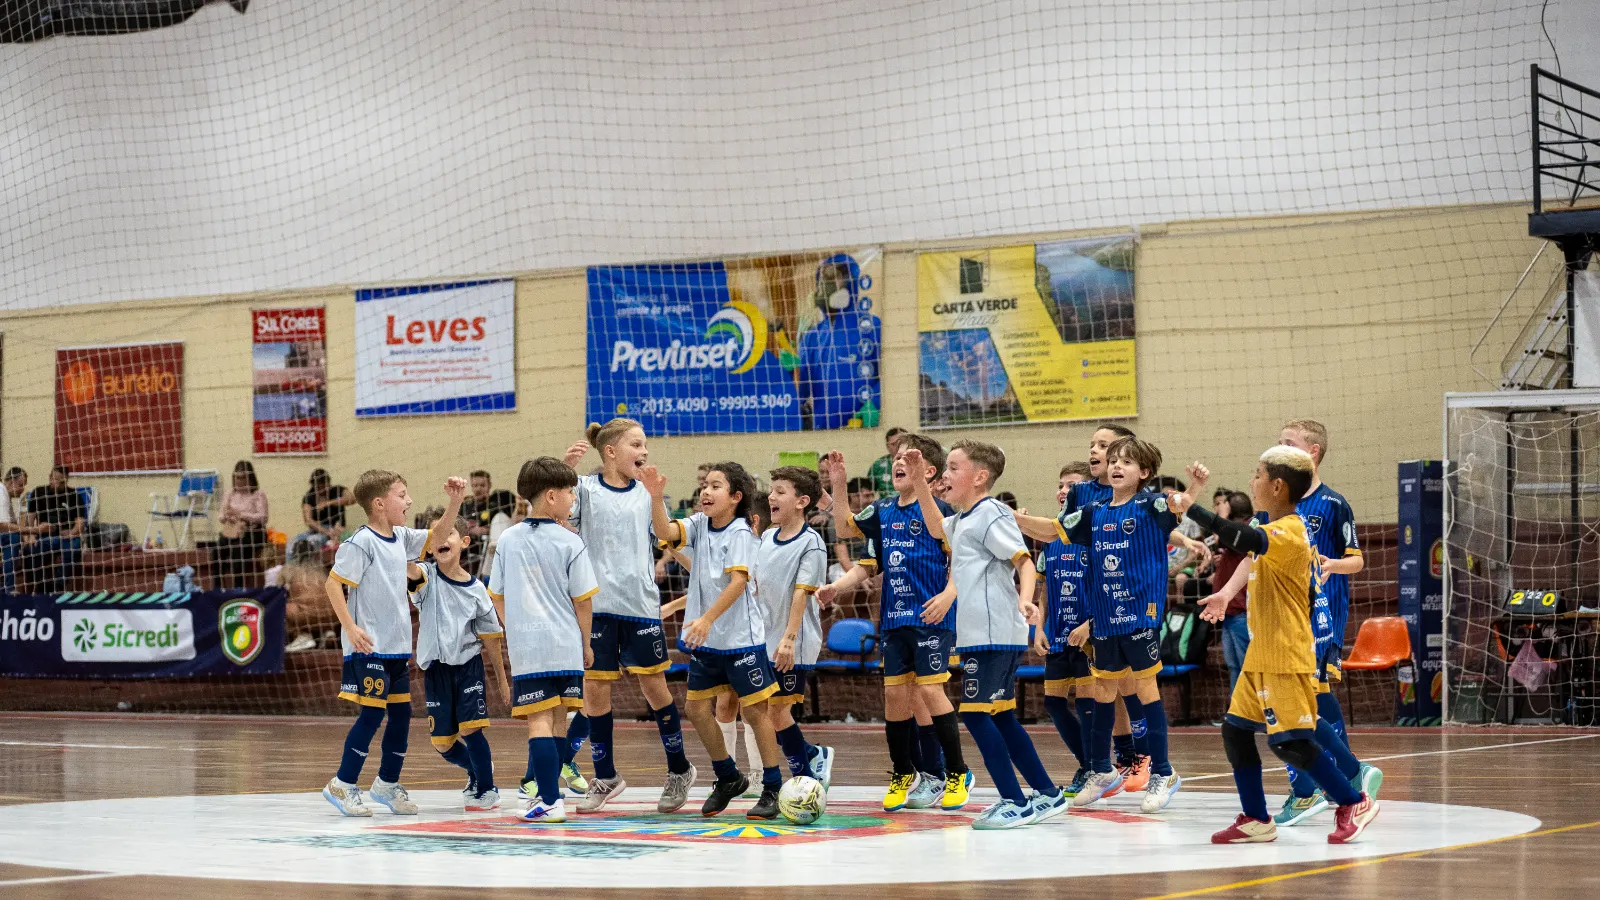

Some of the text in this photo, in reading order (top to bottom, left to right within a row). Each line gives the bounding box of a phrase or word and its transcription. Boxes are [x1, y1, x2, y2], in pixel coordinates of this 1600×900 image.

[933, 298, 1018, 315] CARTA VERDE
[280, 315, 319, 333] CORES
[386, 315, 486, 345] Leves
[610, 338, 735, 372] Previnset
[642, 397, 708, 413] 2013.4090
[1102, 540, 1129, 551] Sicredi
[1060, 570, 1083, 578] Sicredi
[893, 583, 911, 595] petri
[1510, 591, 1525, 605] 2
[1541, 592, 1556, 607] 0
[1062, 605, 1074, 614] vdr
[1146, 602, 1157, 621] 4
[0, 609, 54, 641] hão
[103, 623, 178, 648] Sicredi
[363, 676, 385, 696] 99
